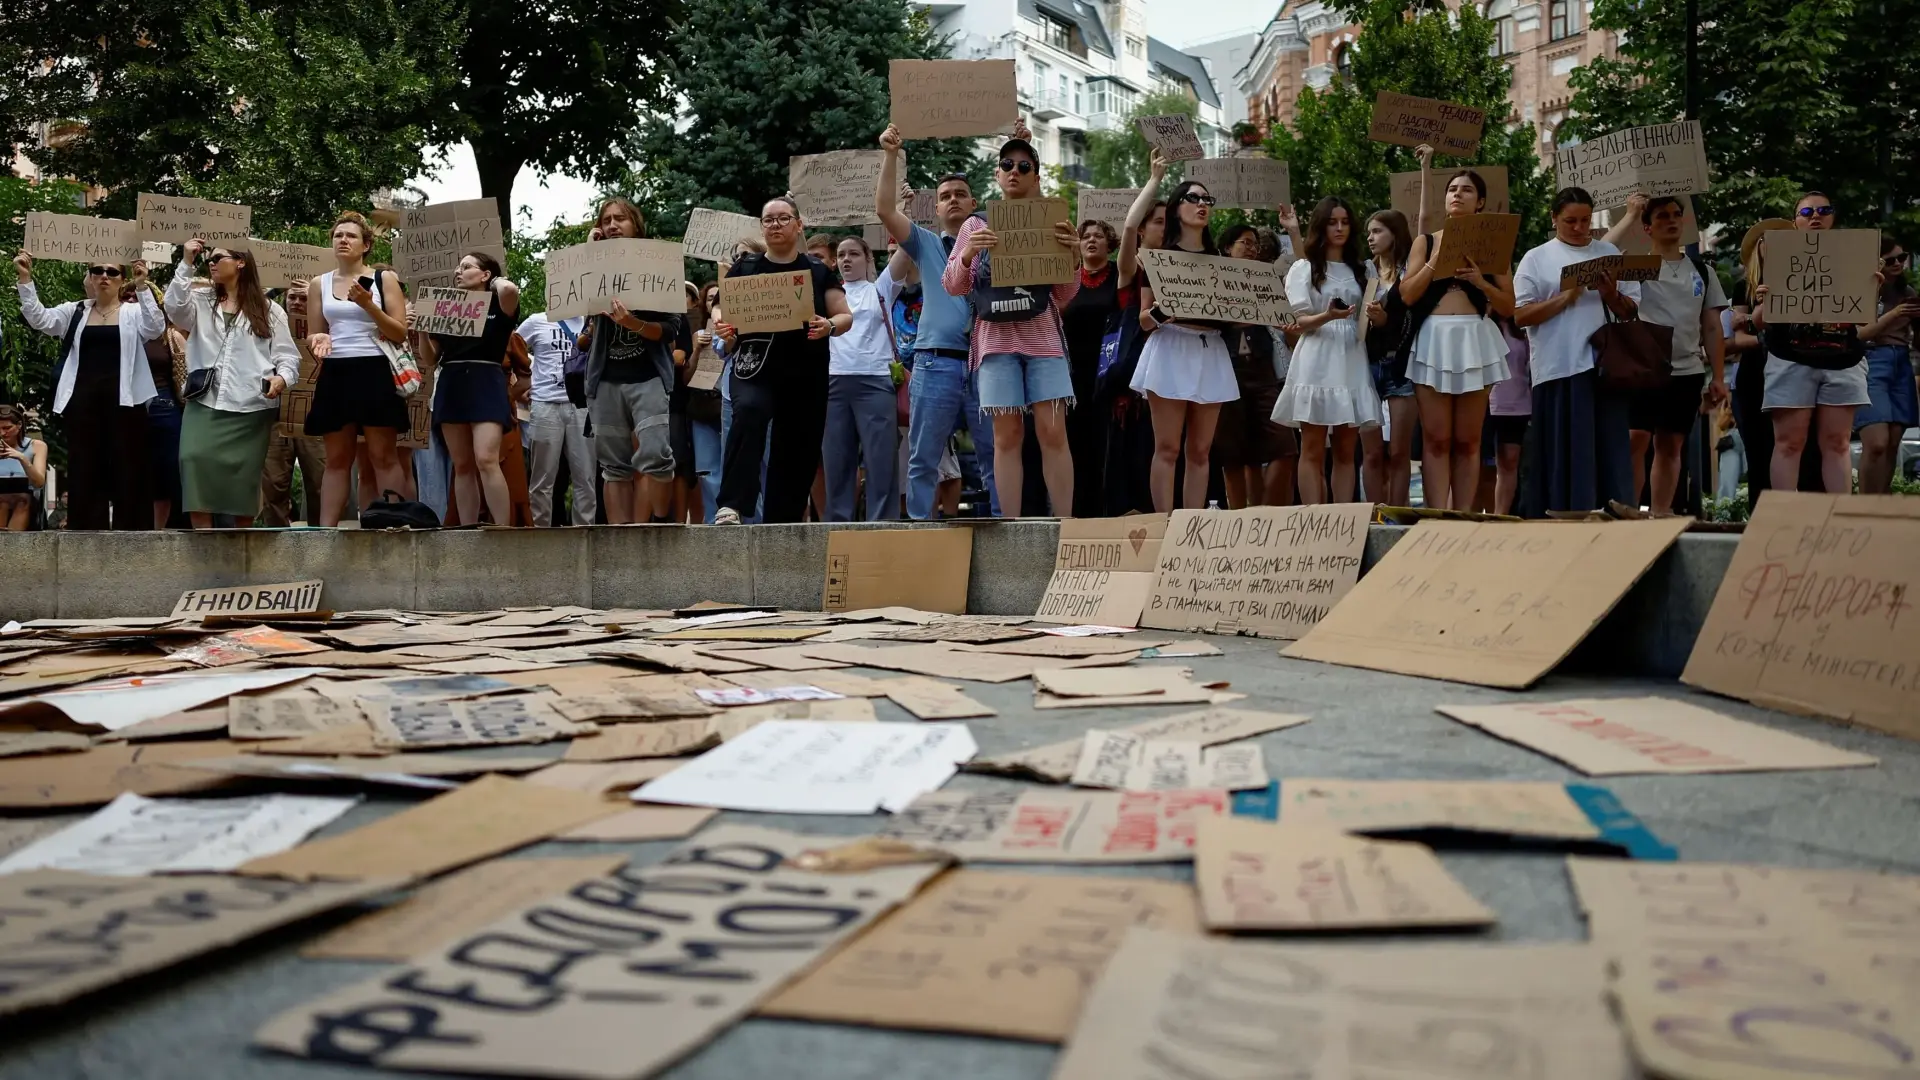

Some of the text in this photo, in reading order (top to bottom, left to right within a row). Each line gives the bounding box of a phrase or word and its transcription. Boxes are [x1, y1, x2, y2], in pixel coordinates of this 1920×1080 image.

[1438, 104, 1482, 125] ФЕДОРОВ
[1557, 147, 1577, 174] НІ
[1568, 150, 1667, 188] ФЕДОРОВА
[200, 206, 223, 218] ВСЕ
[228, 211, 245, 220] ЦЕ
[32, 219, 116, 239] НА ВІЙНІ
[256, 242, 304, 255] ФЕДОРОВ
[406, 226, 471, 253] КАНІКУЛИ
[1804, 233, 1819, 254] У
[85, 243, 143, 261] КАНІКУЛ
[993, 257, 1025, 282] ПІЗДА
[1791, 255, 1830, 273] ВАС
[597, 273, 608, 298] А
[612, 272, 633, 294] НЕ
[637, 272, 677, 293] ФІЧА
[724, 274, 789, 293] СИРСЬКИЙ
[1786, 274, 1833, 292] СИР
[418, 287, 470, 301] НА ФРОНТІ
[724, 289, 783, 305] ФЕДОРОВ
[433, 301, 485, 320] НЕМАЄ
[728, 307, 741, 315] ЦЕ
[991, 297, 1031, 313] PUMA
[1166, 299, 1269, 322] ФЕДОРОВА
[1770, 295, 1863, 315] ПРОТУХ
[414, 316, 477, 336] КАНІКУЛ
[745, 315, 756, 323] ЦЕ
[1176, 517, 1244, 551] ЯКЩО
[1246, 517, 1275, 548] ВИ
[1764, 524, 1873, 562] СВОГО
[1060, 543, 1121, 569] ФЕДОРОВ
[1297, 556, 1314, 572] НА
[1050, 571, 1111, 591] МІНІСТР
[1306, 579, 1334, 595] ВАМ
[180, 582, 321, 613] ІННОВАЦІЇ
[1040, 593, 1105, 618] ОБОРОНИ
[1151, 595, 1163, 610] В
[1229, 601, 1243, 615] ТО
[1247, 602, 1266, 618] ВИ
[1738, 562, 1912, 632] ФЕДОРОВА
[1715, 630, 1798, 664] КОЖНЕ
[308, 841, 786, 1070] ФЕДОРОВ
